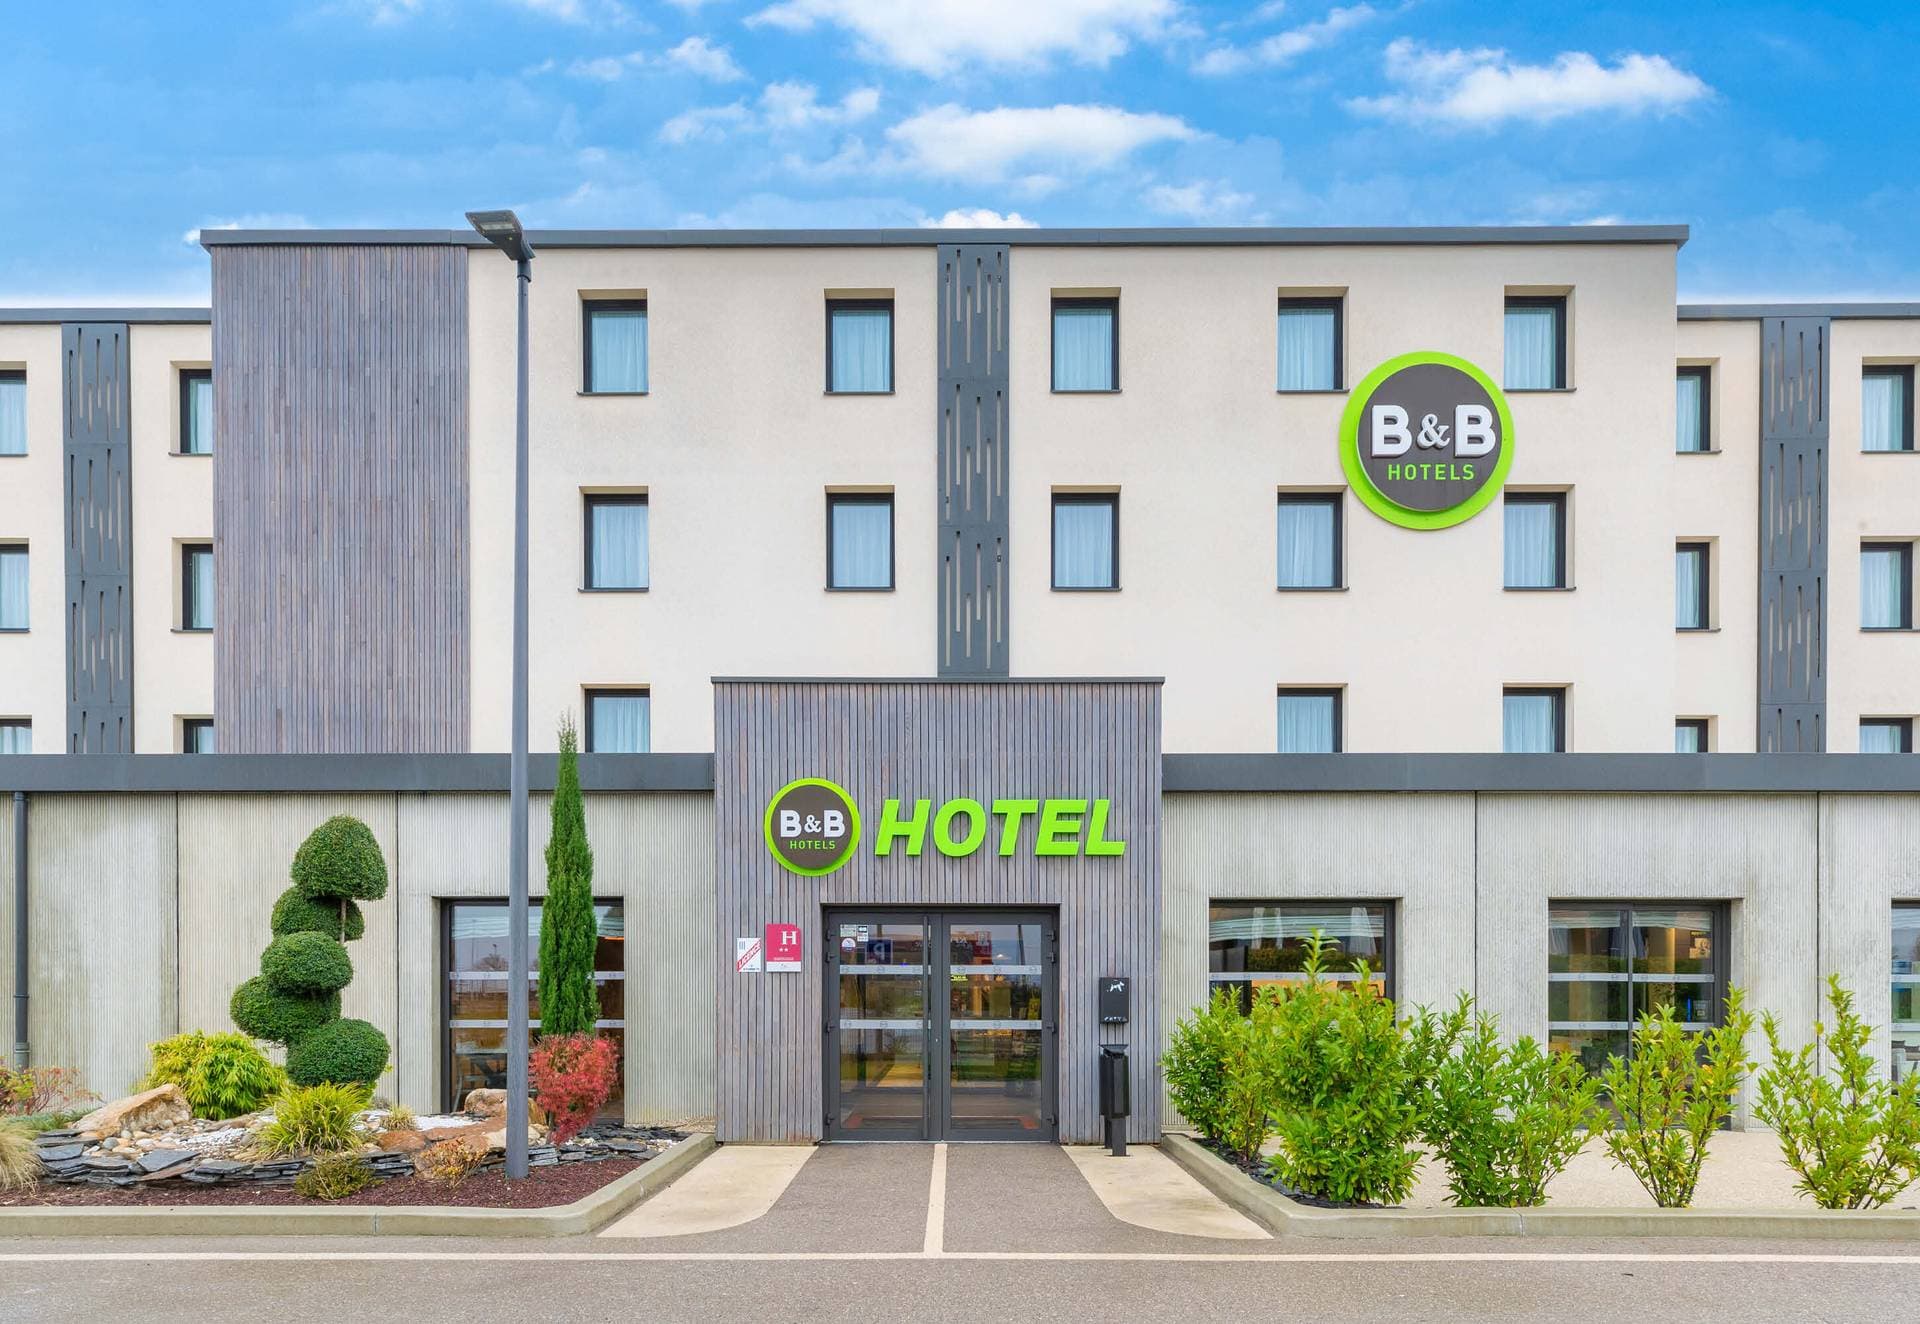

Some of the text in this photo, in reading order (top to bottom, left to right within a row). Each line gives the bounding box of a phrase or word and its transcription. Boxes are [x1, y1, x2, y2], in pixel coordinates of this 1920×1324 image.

[1372, 404, 1496, 458] B&B
[1388, 464, 1475, 481] HOTELS
[780, 809, 846, 838] B&B
[875, 798, 1127, 857] HOTEL
[789, 840, 836, 849] HOTELS
[781, 930, 798, 945] H
